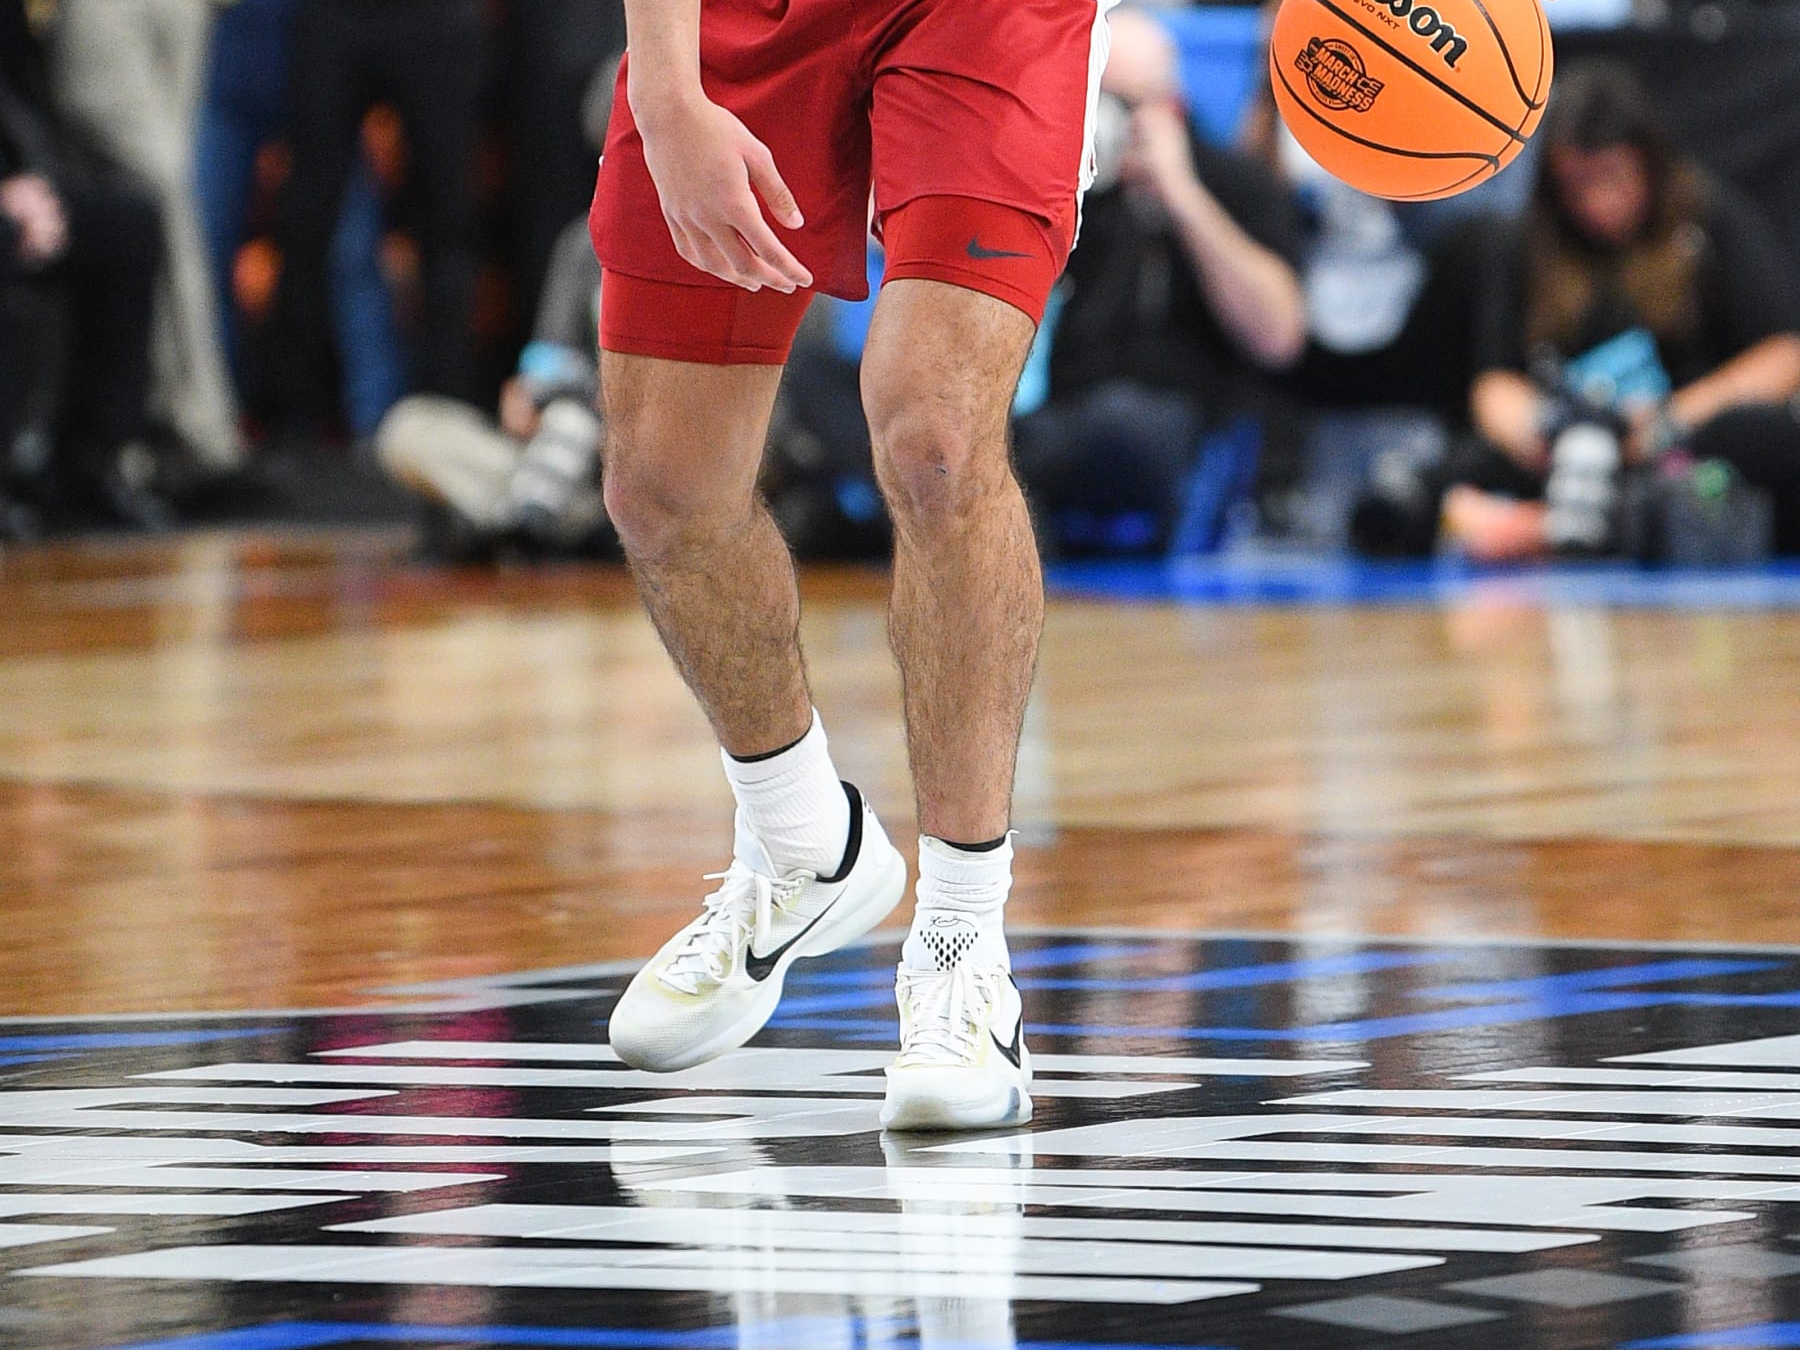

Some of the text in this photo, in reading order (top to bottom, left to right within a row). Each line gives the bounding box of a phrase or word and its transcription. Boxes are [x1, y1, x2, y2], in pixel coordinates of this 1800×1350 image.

[1376, 11, 1400, 30] NXT
[1315, 47, 1359, 85] MARCH
[1313, 64, 1374, 110] MADNESS
